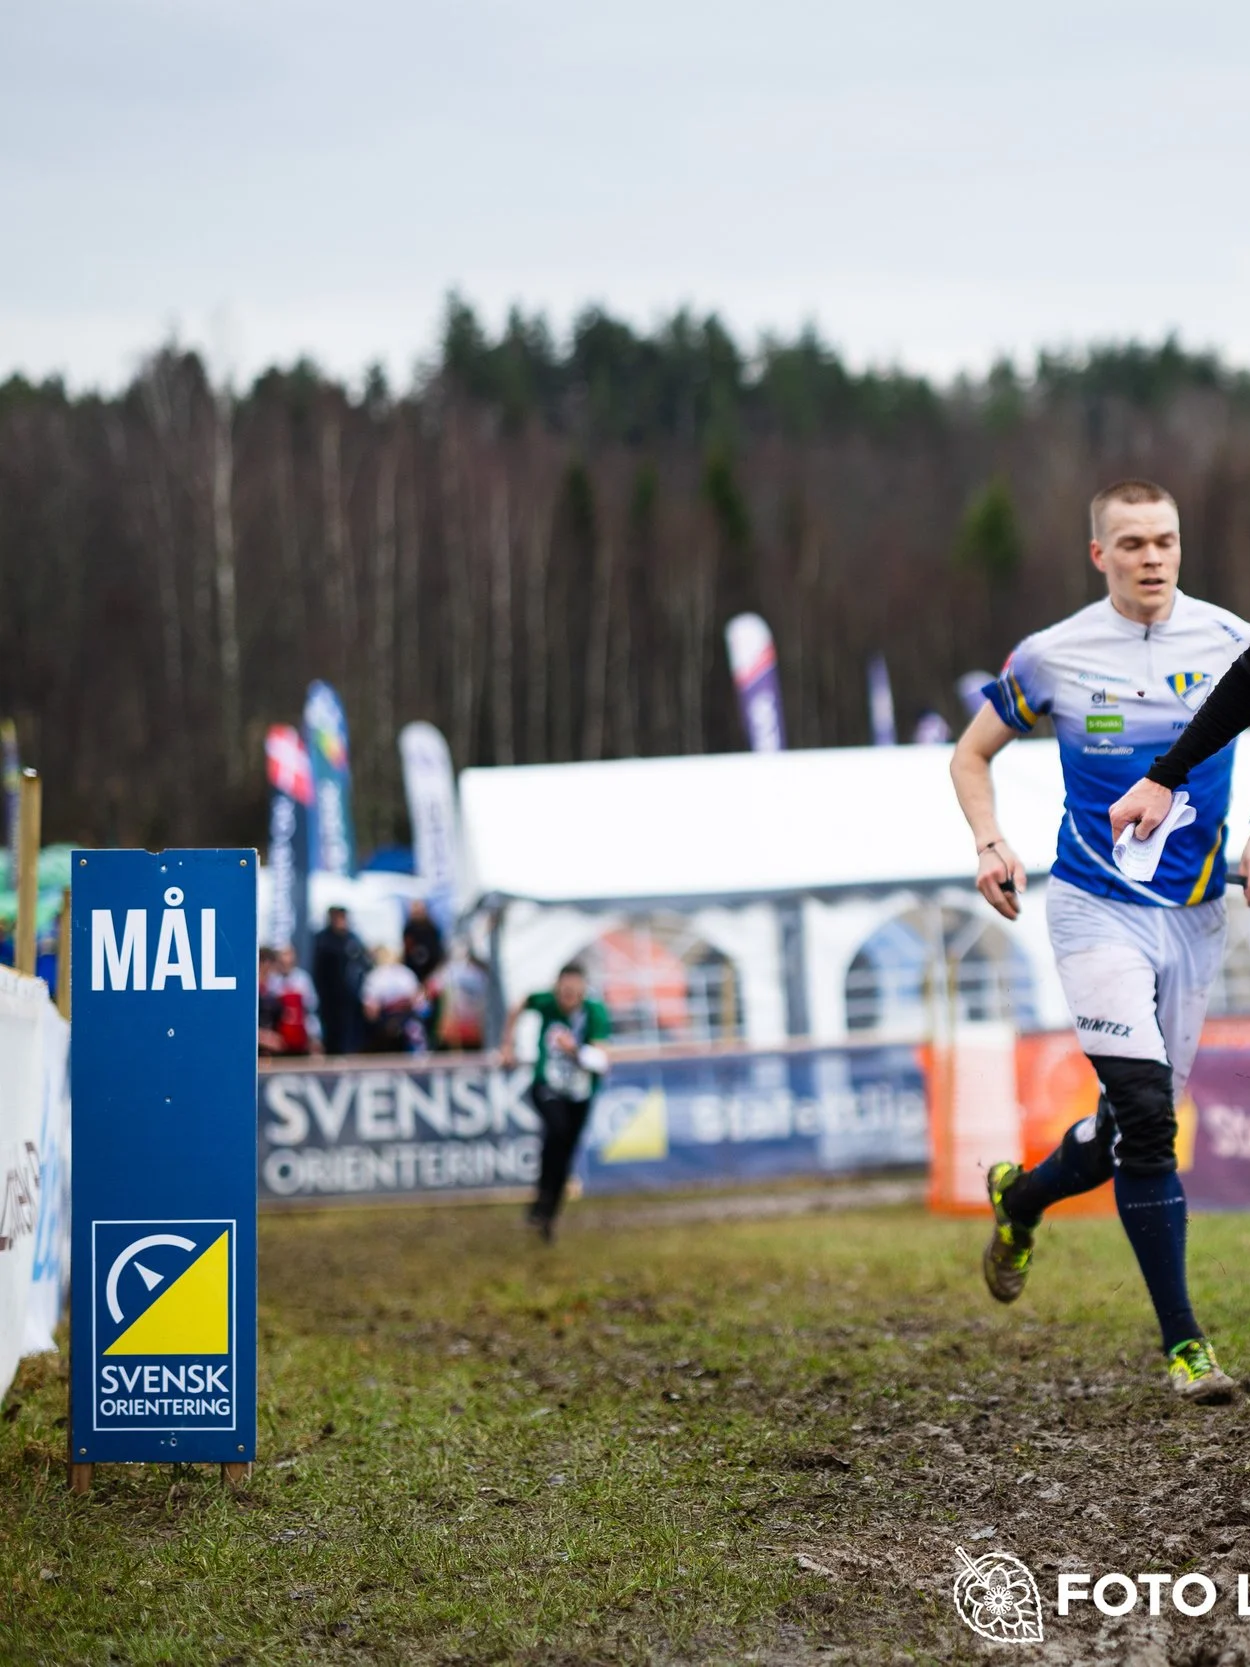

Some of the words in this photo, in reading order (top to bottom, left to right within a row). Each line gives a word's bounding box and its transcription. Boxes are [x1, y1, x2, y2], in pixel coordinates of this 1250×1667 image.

[91, 886, 237, 991] MÅL
[1075, 1016, 1134, 1038] TRIMTEX
[265, 1066, 544, 1147] SVENSK
[264, 1134, 543, 1195] ORIENTERING
[101, 1364, 229, 1394] SVENSK
[100, 1398, 231, 1417] ORIENTERING
